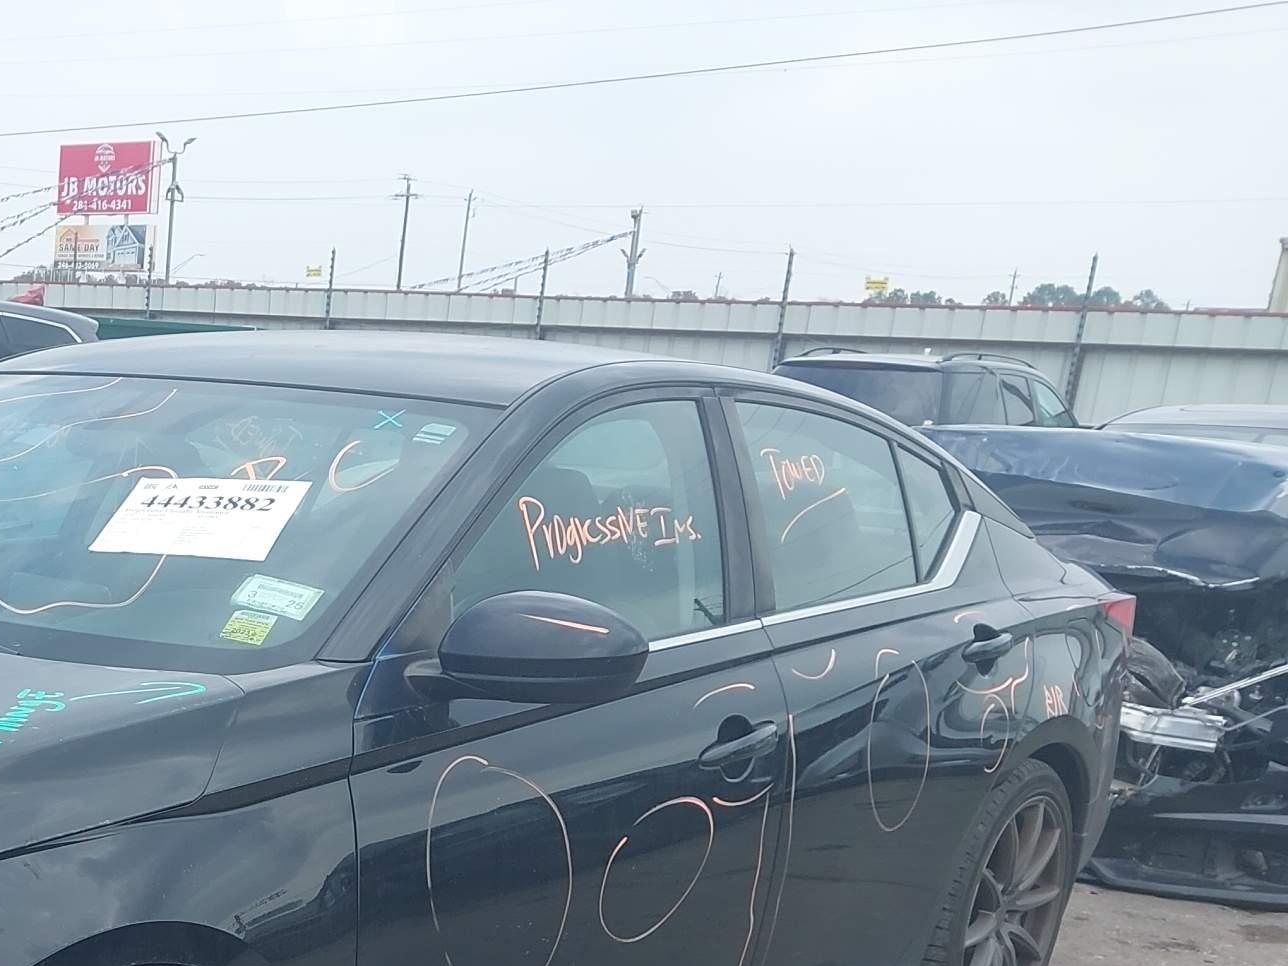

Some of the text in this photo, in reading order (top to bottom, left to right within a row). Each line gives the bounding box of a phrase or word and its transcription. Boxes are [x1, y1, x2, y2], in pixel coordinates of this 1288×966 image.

[62, 174, 146, 197] JB MOTORS
[140, 494, 276, 512] 44433882
